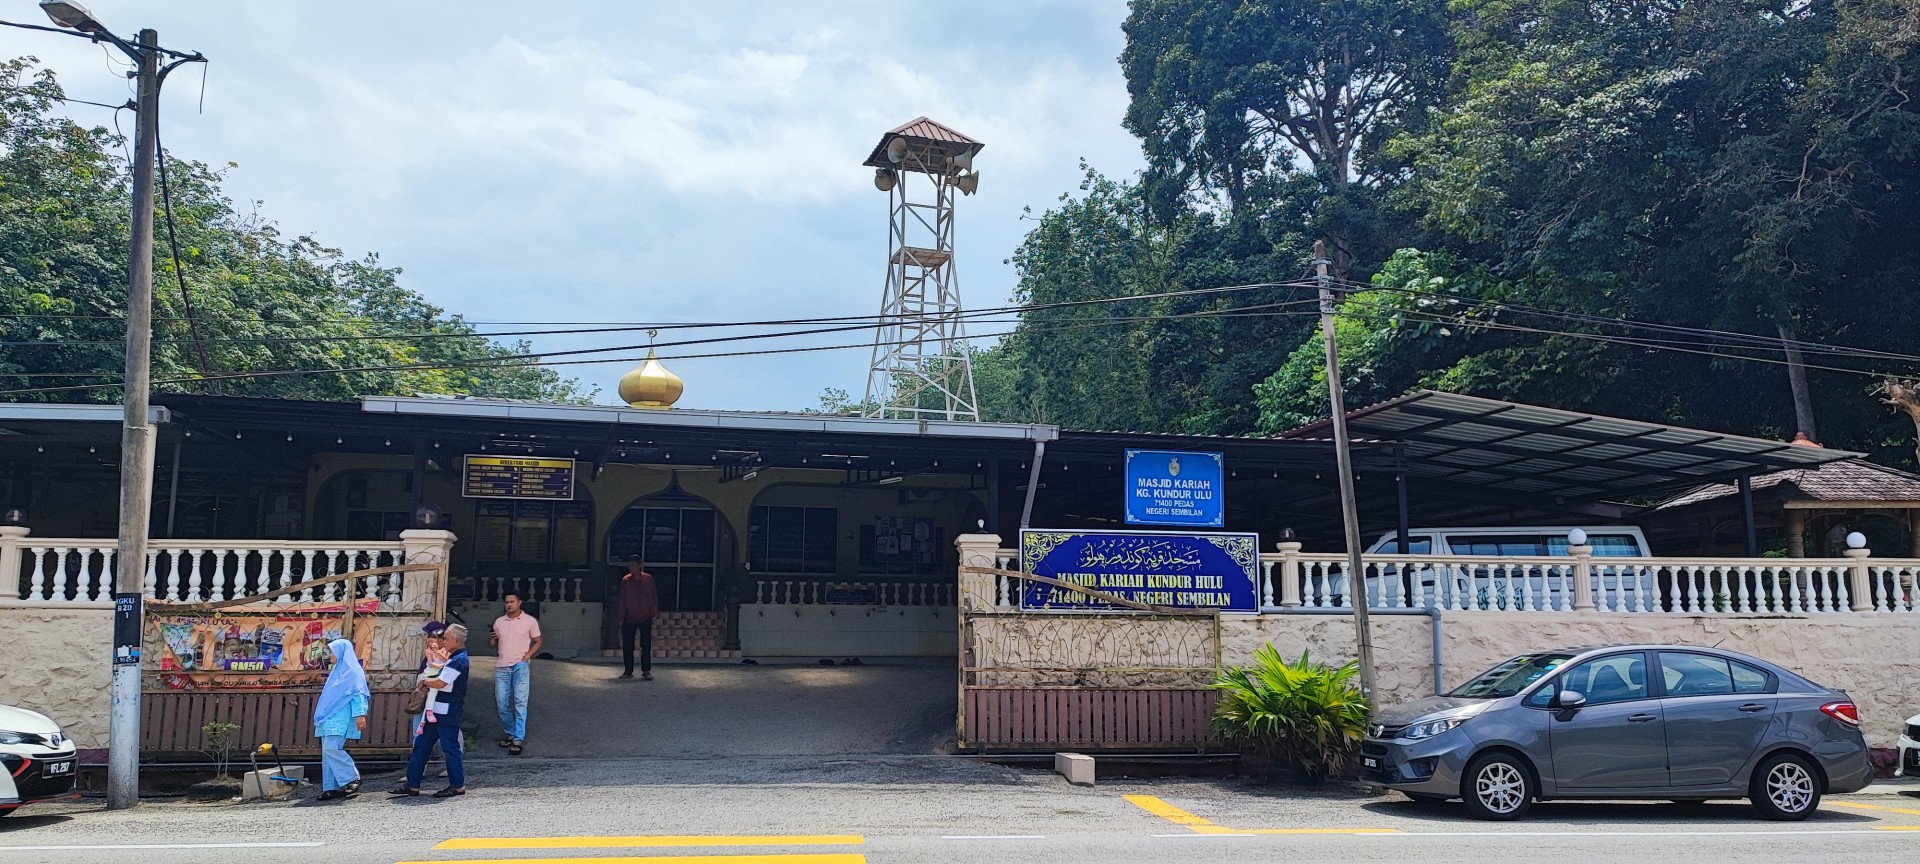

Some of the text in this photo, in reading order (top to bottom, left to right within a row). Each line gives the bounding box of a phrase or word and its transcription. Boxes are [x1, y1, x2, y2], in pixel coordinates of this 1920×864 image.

[1138, 478, 1210, 489] MASJID KARIAH
[1136, 488, 1212, 500] KG. KUNDUR ULU
[1154, 499, 1194, 508] 71400 PEDAS
[1146, 507, 1203, 516] NEGERI SEMBILAN
[1057, 572, 1223, 589] MASJID KARIAH KUNDUR HULU
[1049, 588, 1086, 604] 71400
[1133, 591, 1174, 605] NEGERI
[1177, 592, 1231, 606] SEMBILAN
[231, 661, 264, 671] RM50
